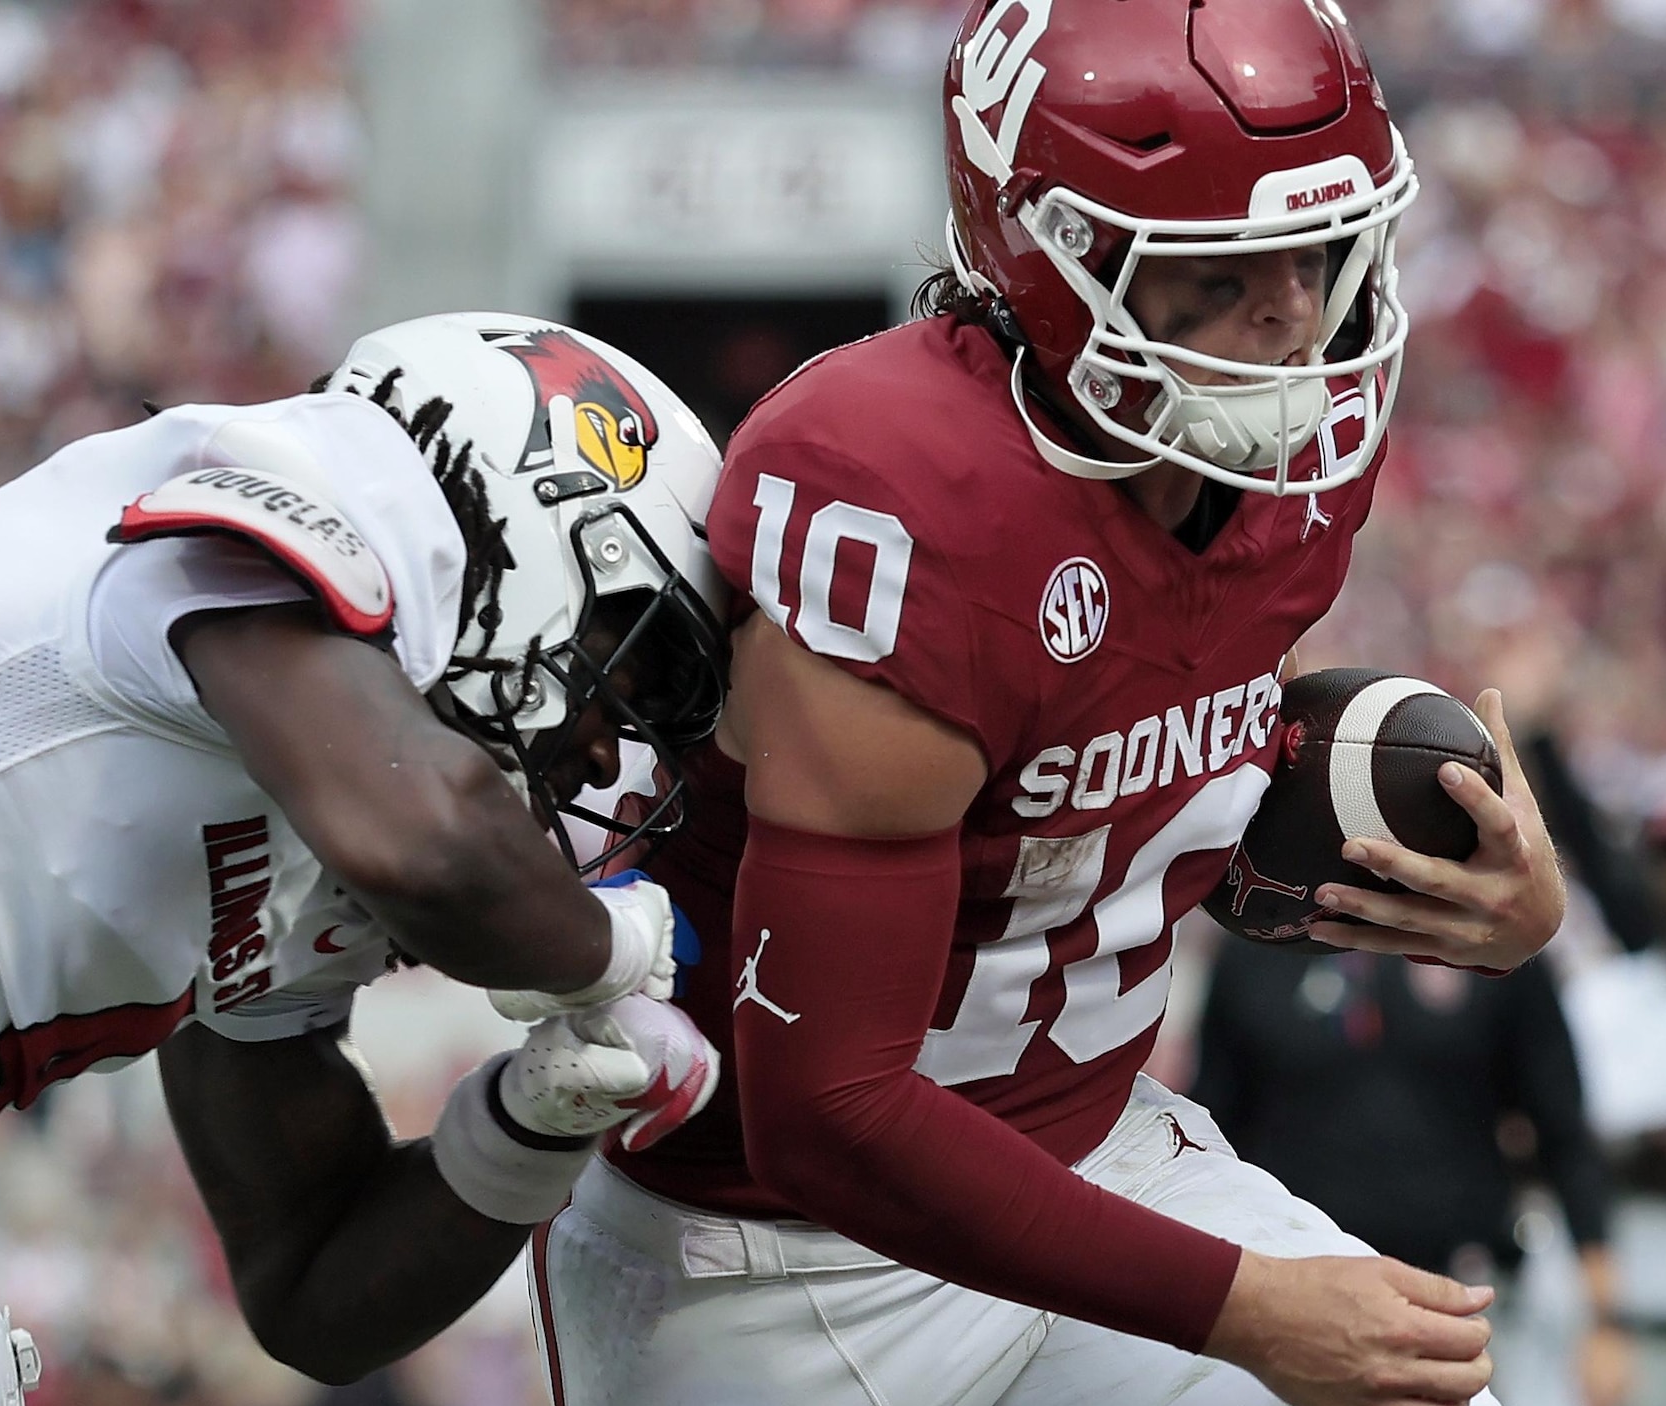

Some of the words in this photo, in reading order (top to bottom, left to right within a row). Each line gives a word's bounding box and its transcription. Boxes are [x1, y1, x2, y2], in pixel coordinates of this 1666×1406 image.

[1285, 178, 1356, 212] OKLAHOMA
[187, 468, 366, 558] DOUGLAS
[749, 472, 914, 665] 10
[1043, 564, 1106, 657] SEC
